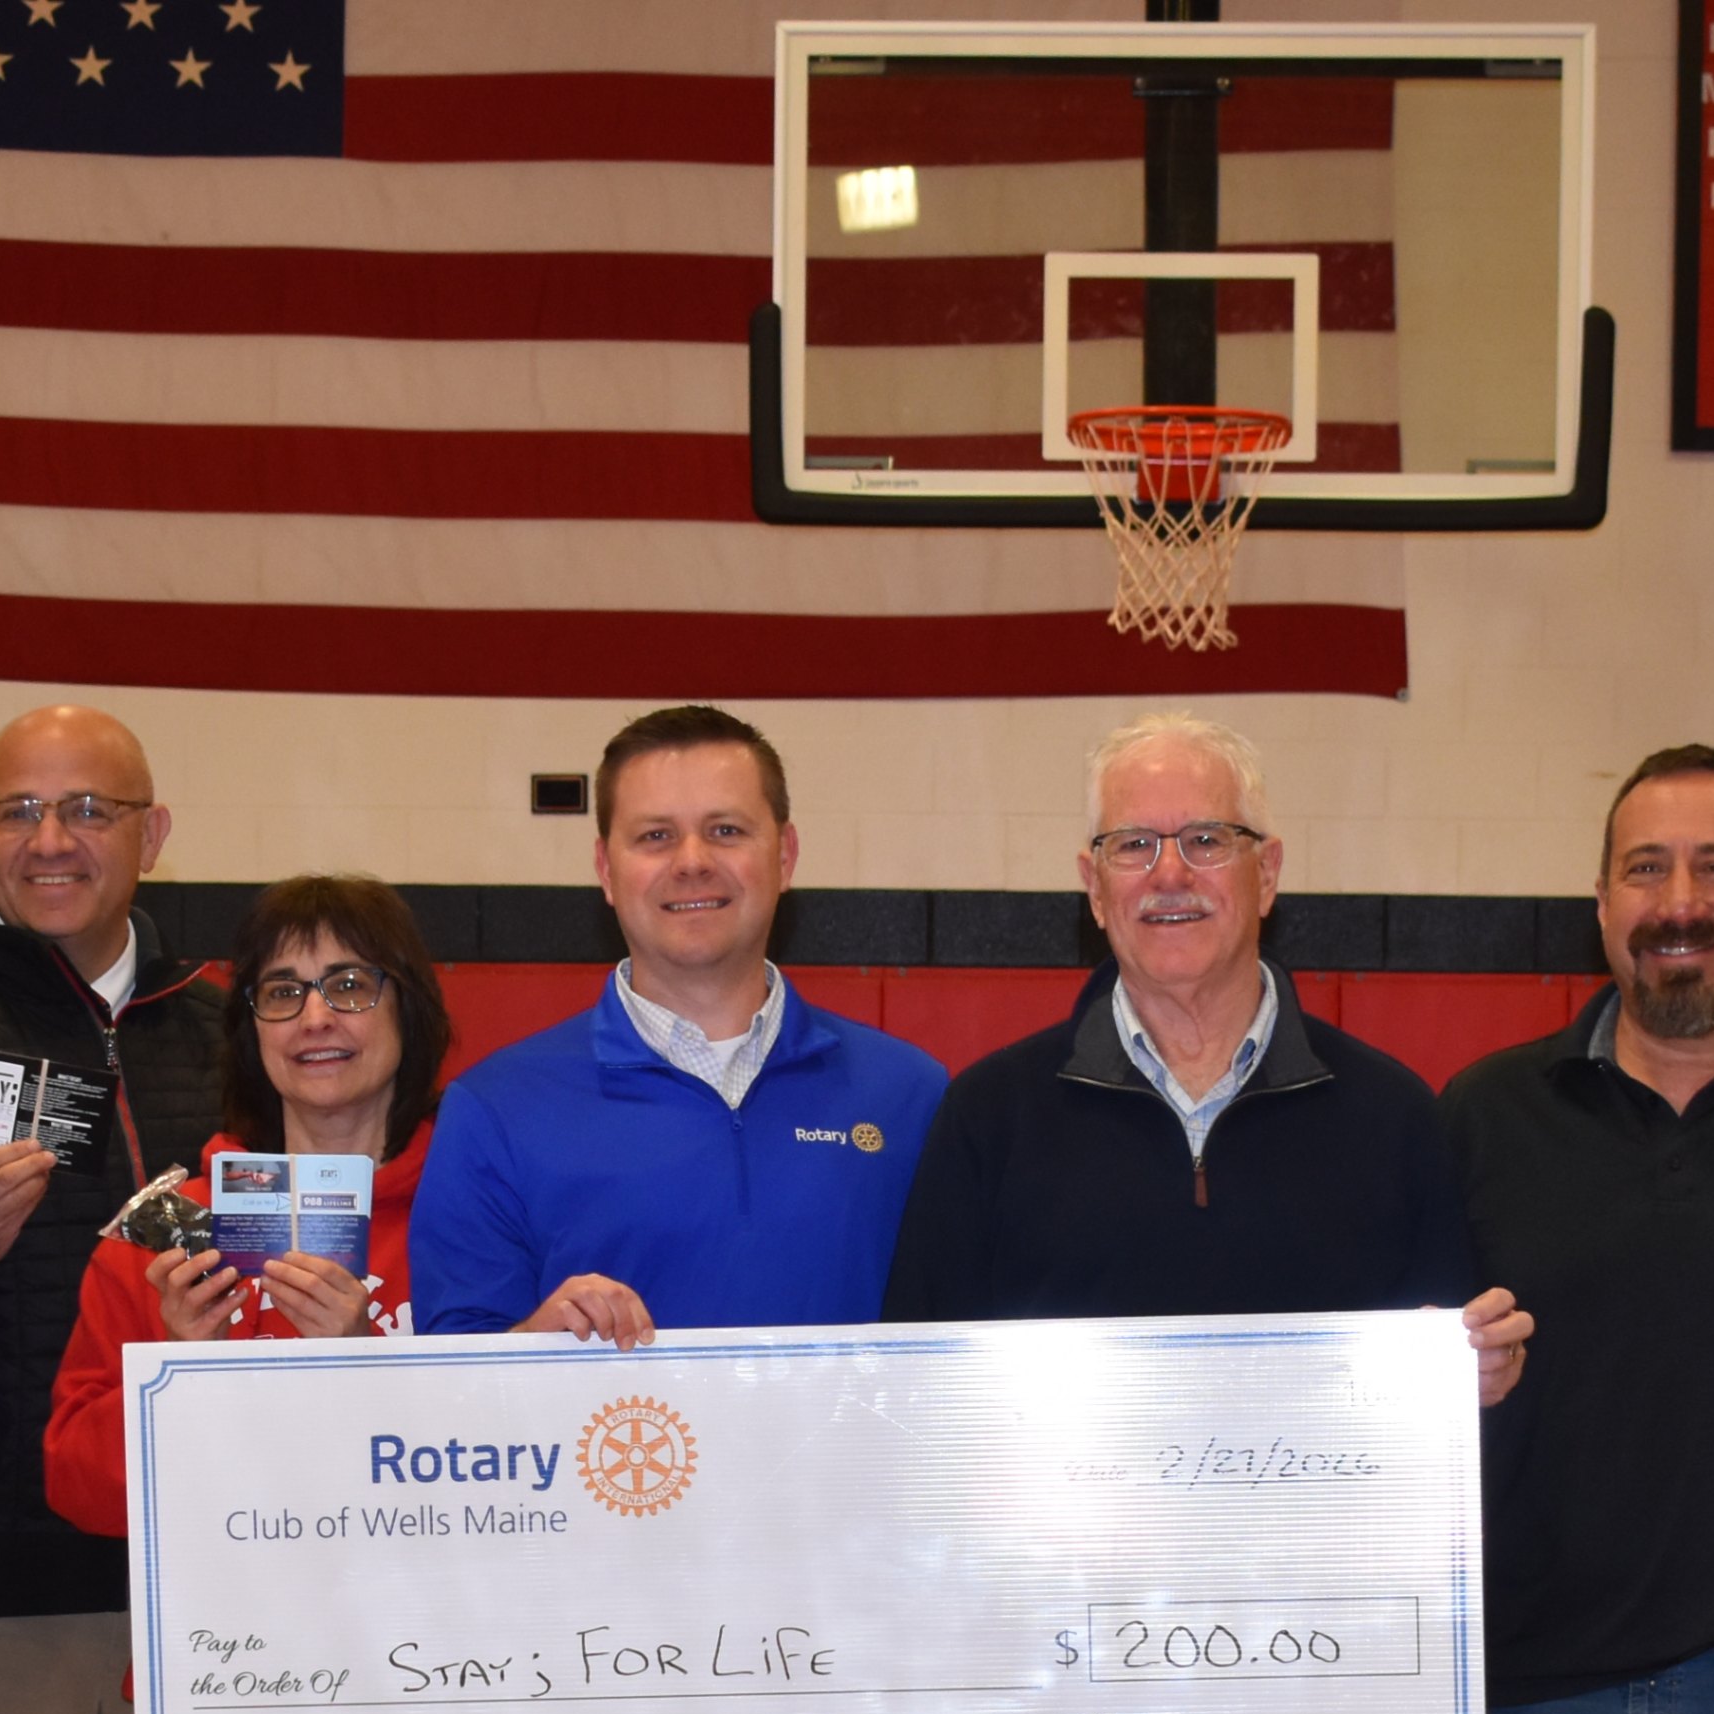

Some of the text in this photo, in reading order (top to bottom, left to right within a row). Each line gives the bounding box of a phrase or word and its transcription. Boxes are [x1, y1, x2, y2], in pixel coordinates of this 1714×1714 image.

[795, 1127, 847, 1145] Rotary
[611, 1408, 662, 1424] ROTARY
[370, 1435, 560, 1491] Rotary
[596, 1473, 680, 1504] INTERNATIONAL
[226, 1506, 568, 1541] Club of Wells Maine
[189, 1629, 267, 1662] Pay to
[578, 1625, 687, 1684] FOR
[1055, 1629, 1079, 1669] $
[1115, 1620, 1341, 1668] 200.00
[190, 1668, 350, 1703] the Order Of
